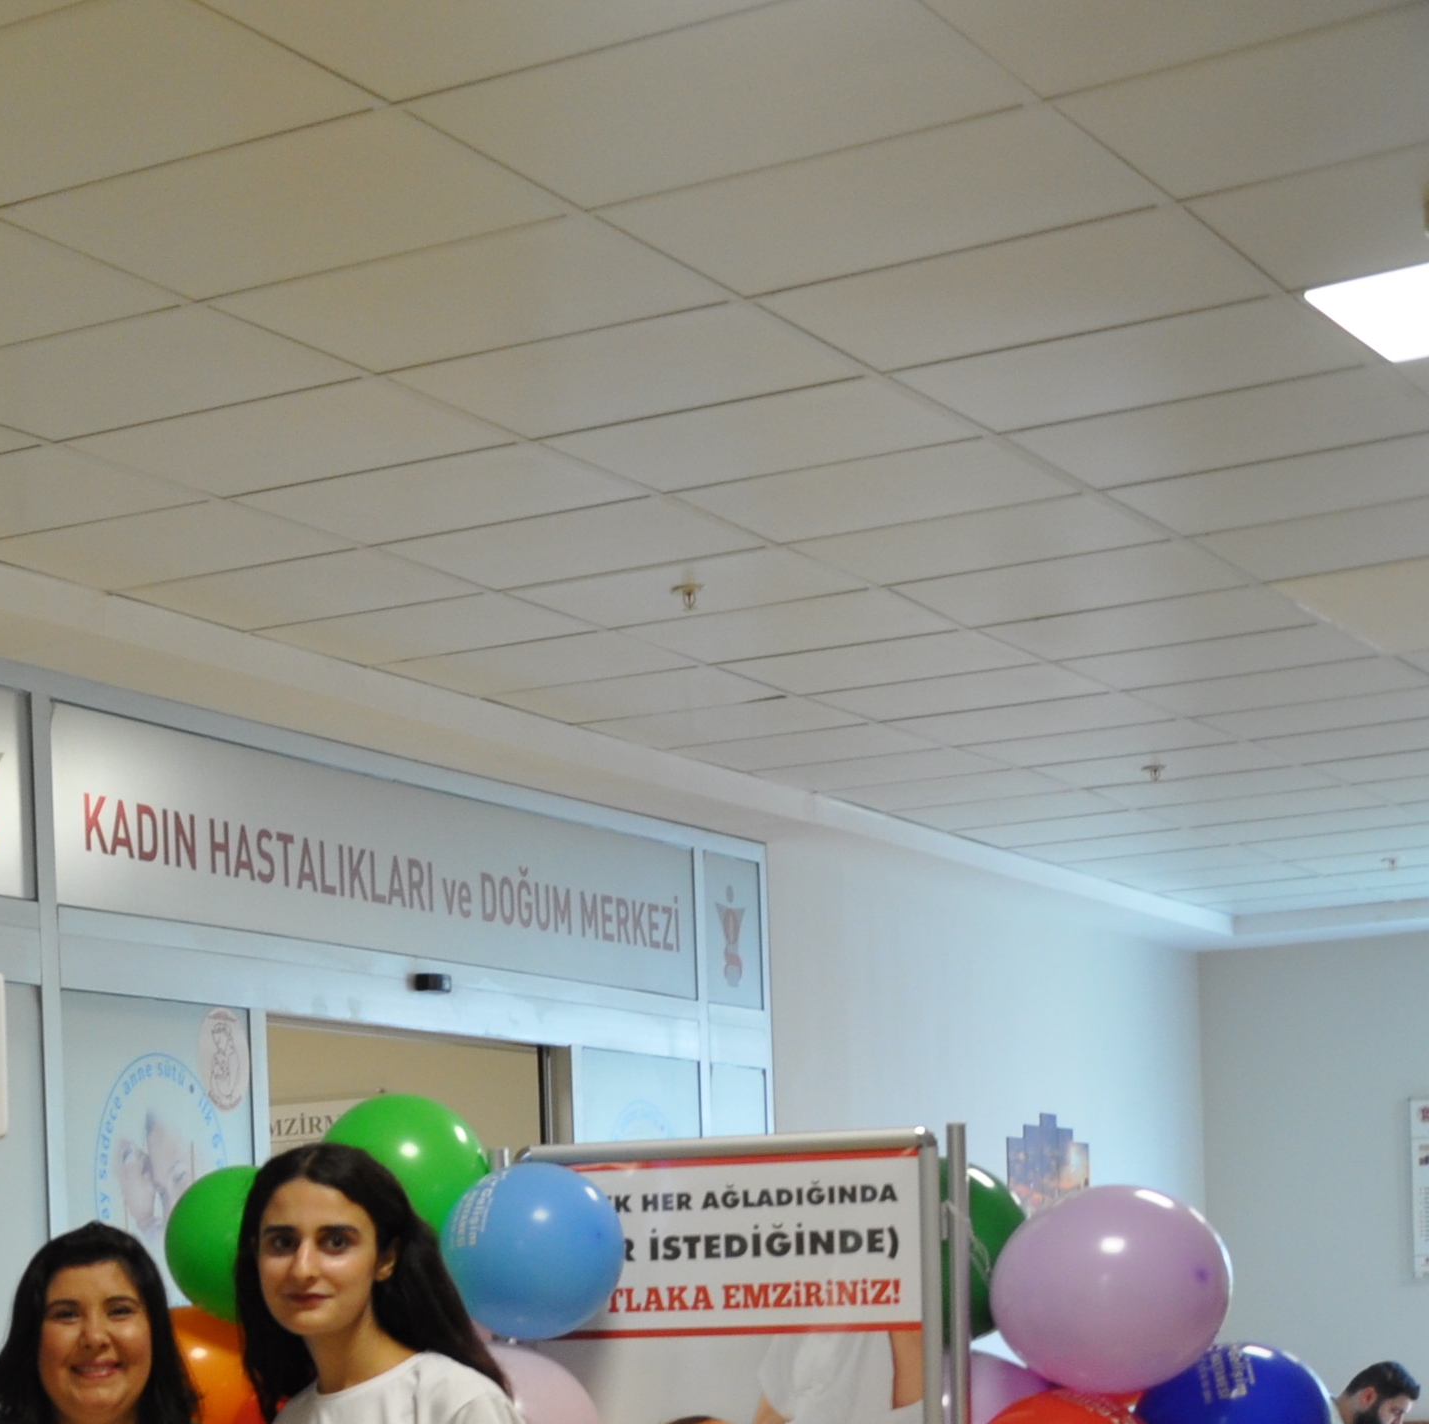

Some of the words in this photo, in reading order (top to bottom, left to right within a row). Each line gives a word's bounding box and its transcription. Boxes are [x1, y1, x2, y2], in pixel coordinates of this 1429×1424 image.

[84, 792, 197, 870] KADIN
[208, 818, 434, 913] HASTALIKLARI
[443, 877, 472, 919] ve
[480, 865, 572, 936] DOĞUM
[579, 895, 680, 952] MERKEZİ
[641, 1192, 692, 1212] HER
[701, 1180, 898, 1210] AĞLADIĞINDA
[649, 1222, 900, 1262] İSTEDİĞİNDE)
